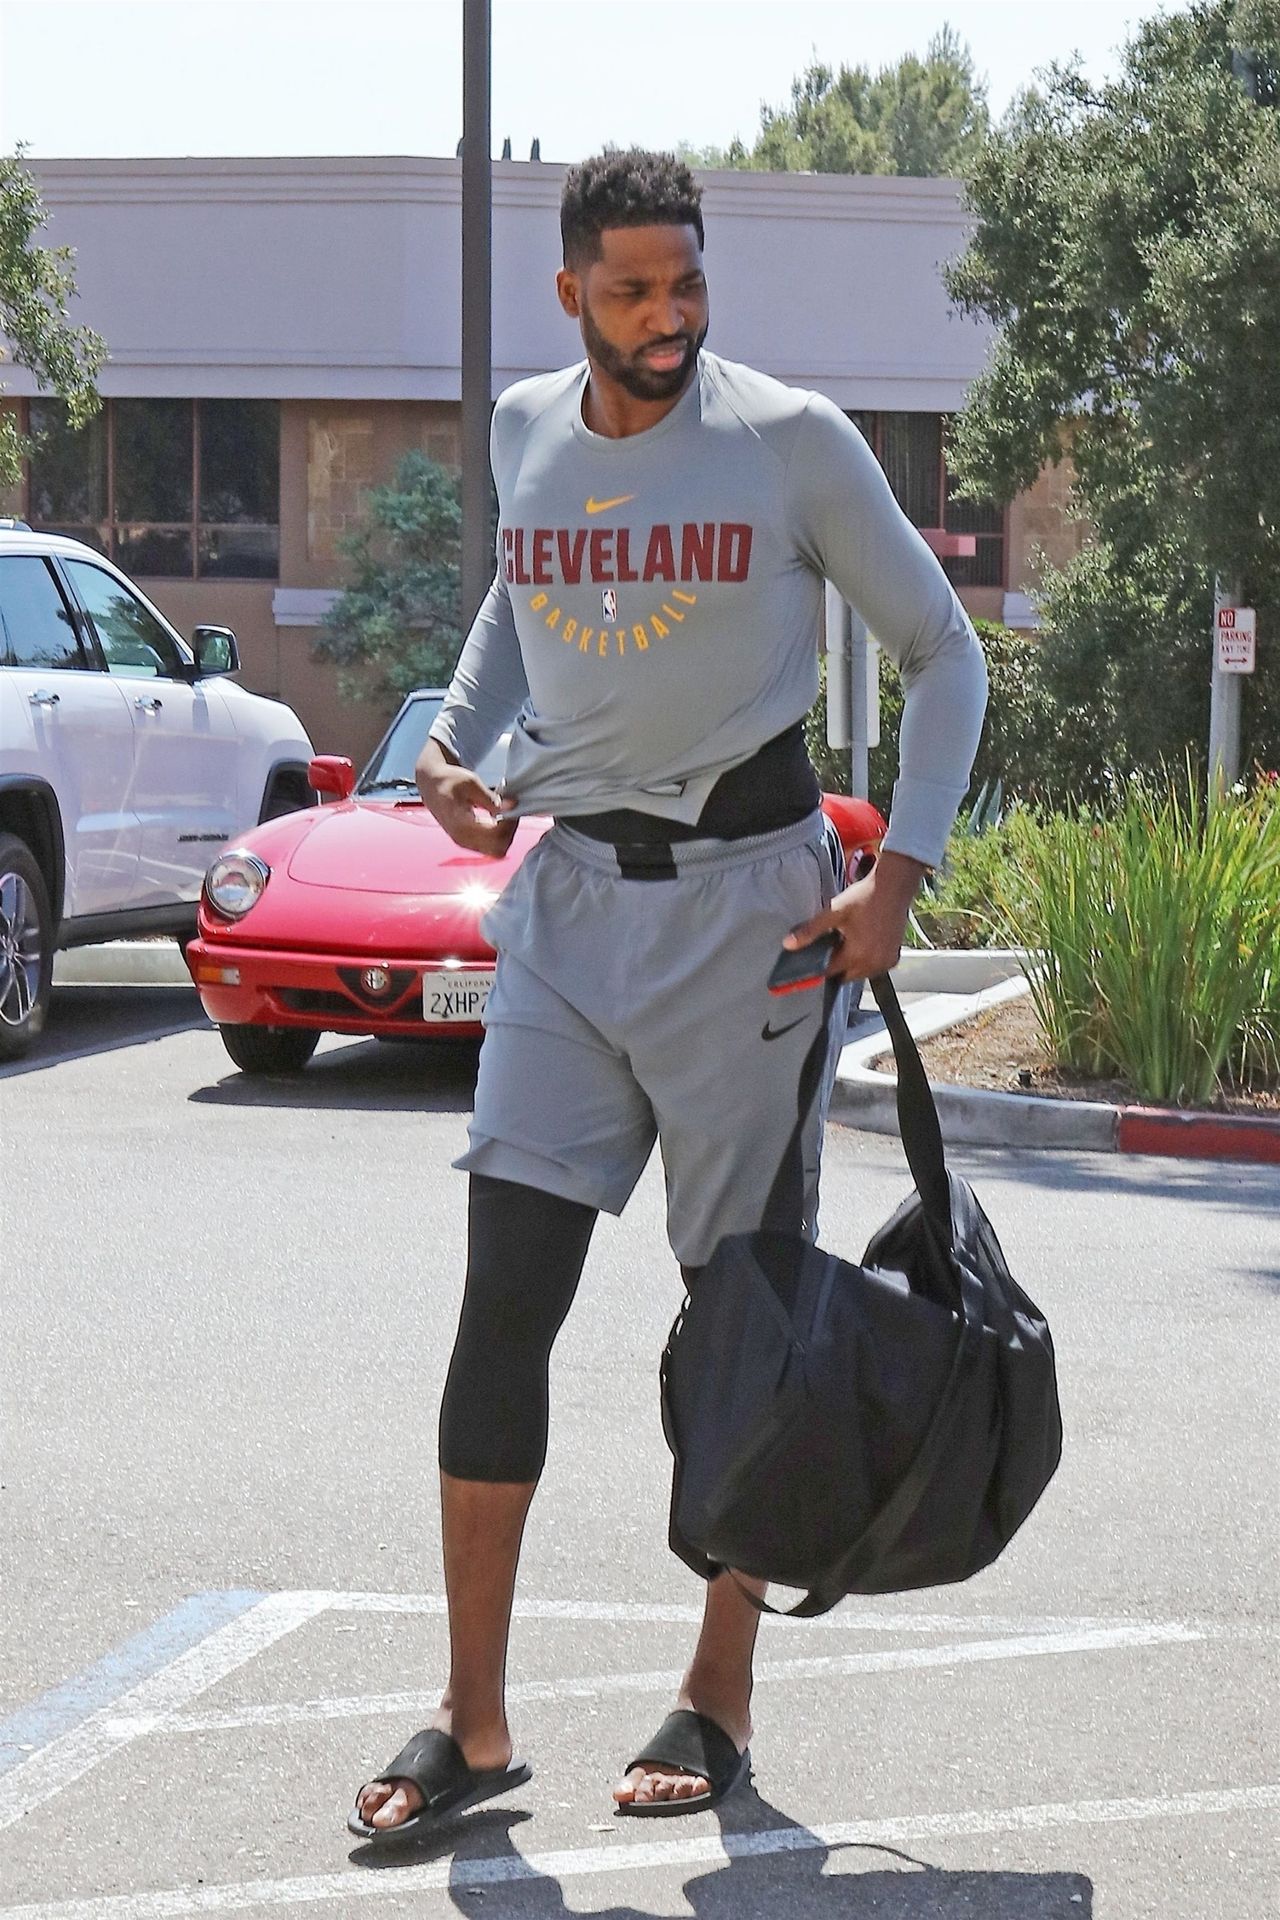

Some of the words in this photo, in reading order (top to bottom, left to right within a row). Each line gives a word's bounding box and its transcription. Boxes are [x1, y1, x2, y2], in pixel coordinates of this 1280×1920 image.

[502, 522, 753, 585] CLEVELAND
[529, 589, 697, 656] BASKETBALL
[1220, 610, 1234, 627] NO
[1220, 631, 1252, 642] PARKING
[447, 980, 495, 988] CALIFORN
